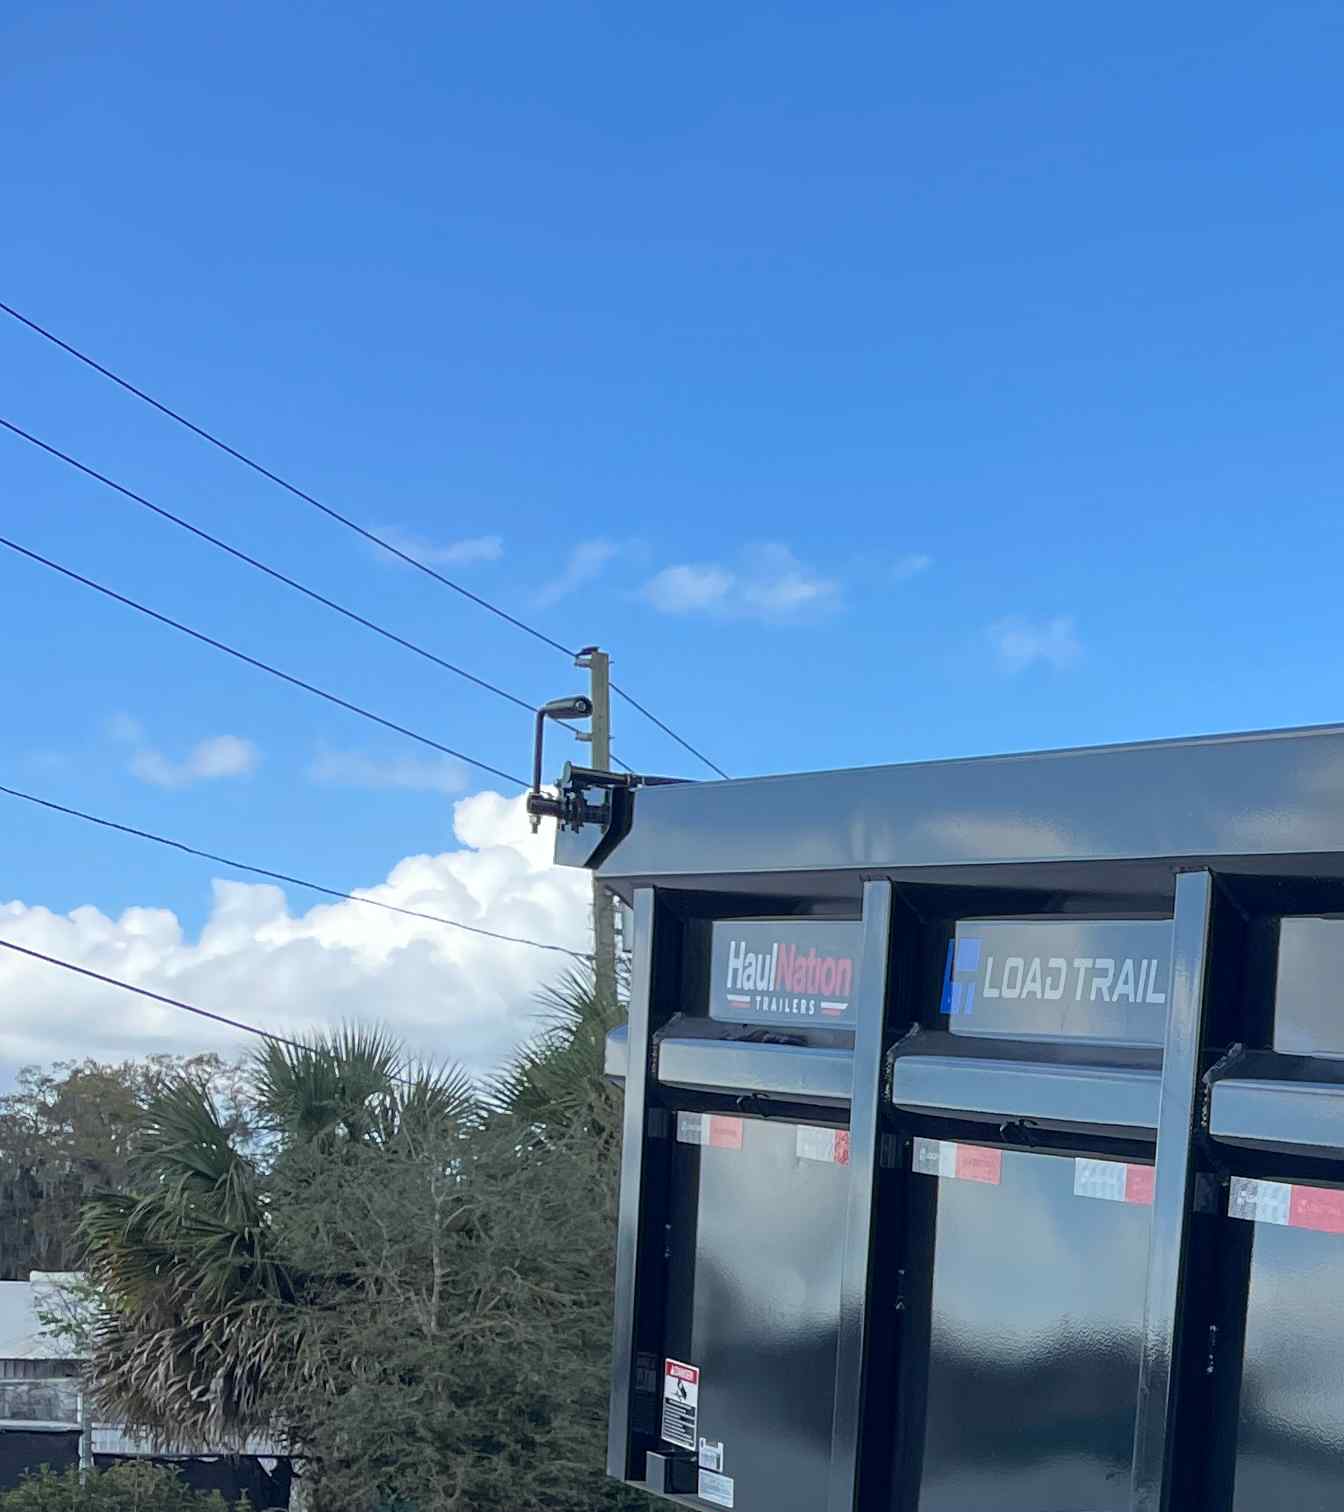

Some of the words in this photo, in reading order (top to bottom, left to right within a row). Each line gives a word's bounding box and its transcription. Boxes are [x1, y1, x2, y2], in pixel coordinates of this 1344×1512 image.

[726, 940, 852, 997] HaulNation
[983, 956, 1067, 1000] LOAD
[1073, 958, 1166, 1004] TRAIL
[755, 995, 815, 1015] TRAILERS
